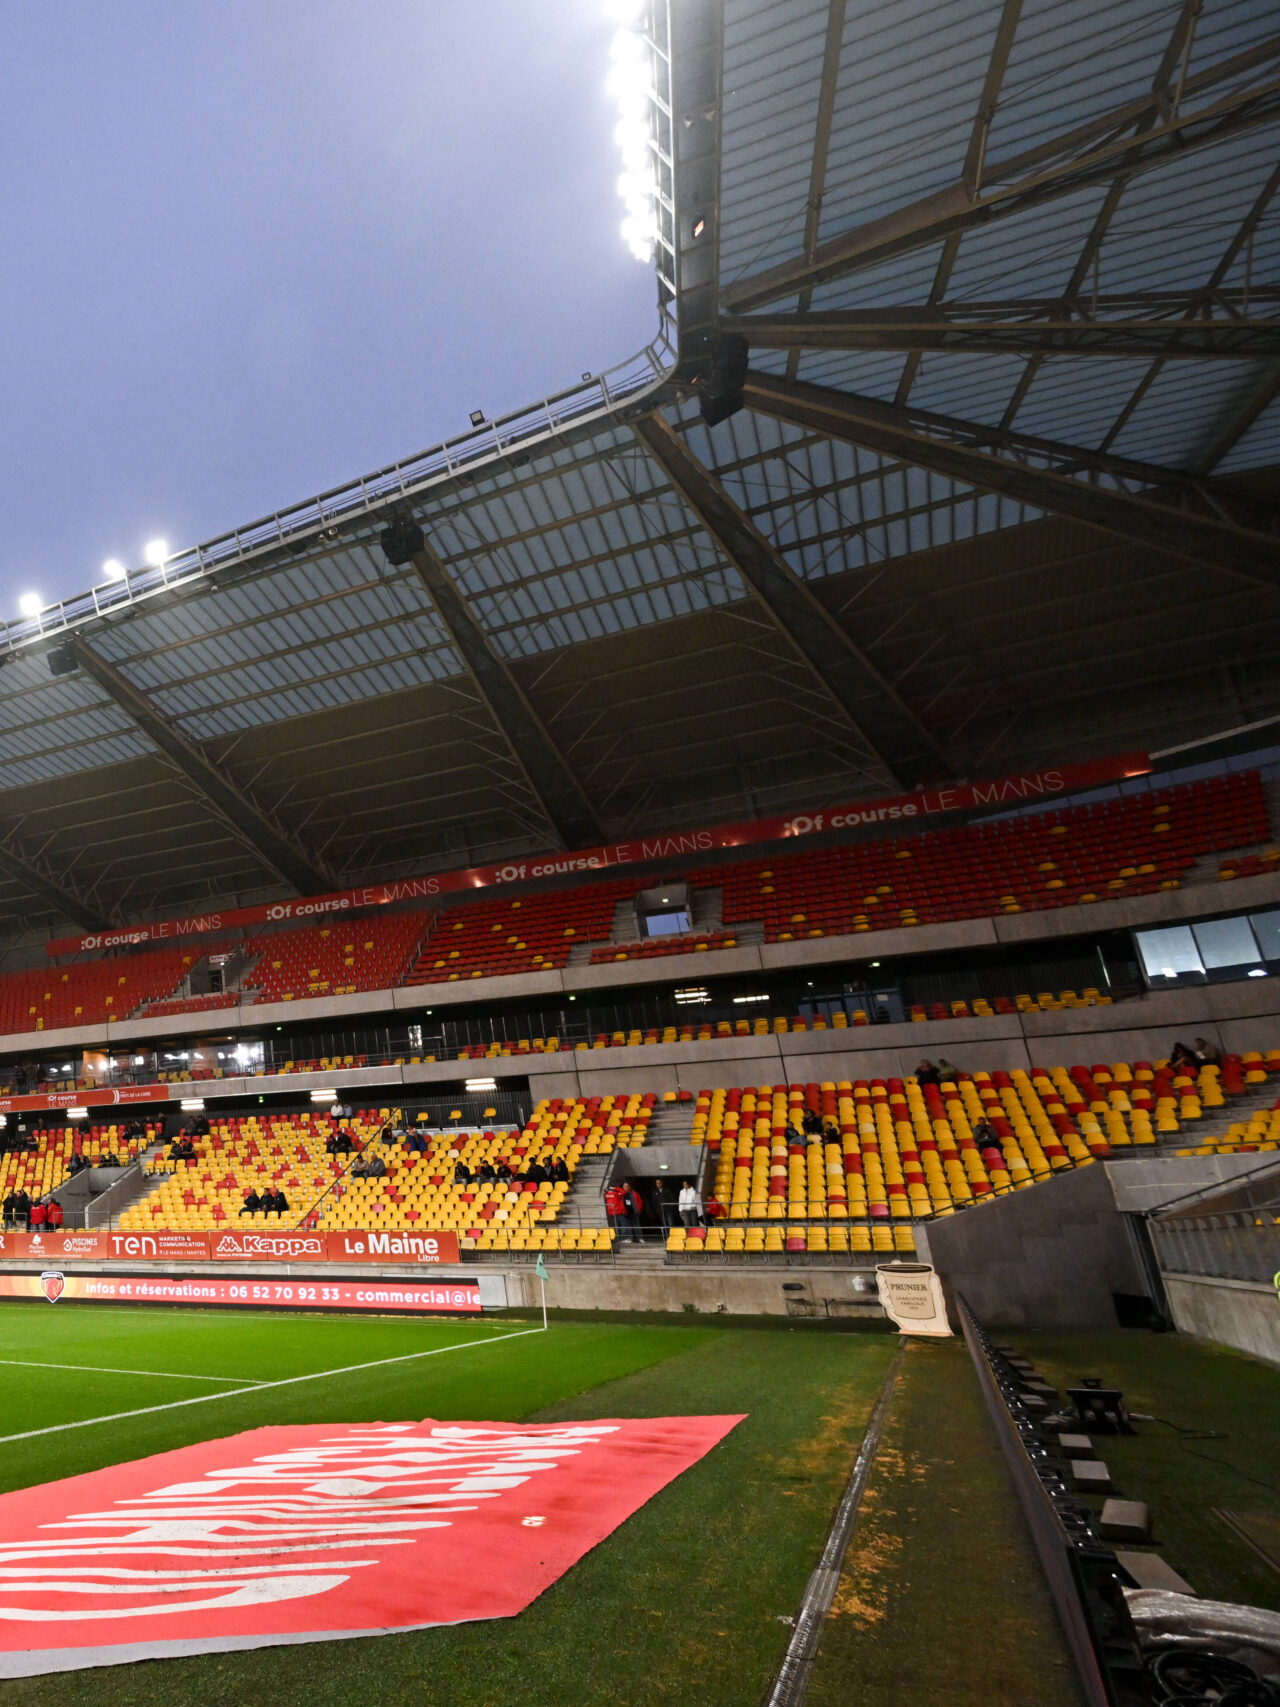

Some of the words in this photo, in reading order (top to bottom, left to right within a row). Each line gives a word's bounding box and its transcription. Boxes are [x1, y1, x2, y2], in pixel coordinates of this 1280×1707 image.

[830, 803, 918, 828] course
[922, 790, 960, 814] LE
[532, 856, 599, 876] course
[603, 845, 632, 864] LE
[642, 832, 712, 859] MANS
[296, 898, 349, 916] course
[352, 889, 375, 906] LE
[383, 878, 440, 900] MANS
[104, 930, 149, 948] course
[151, 923, 169, 939] LE
[176, 915, 221, 935] MANS
[72, 1238, 97, 1246] PISCINES
[244, 1236, 321, 1255] Kappa
[345, 1238, 365, 1253] Le
[368, 1232, 438, 1254] Maine
[86, 1282, 115, 1294] Infos
[120, 1284, 131, 1294] et
[136, 1283, 216, 1297] réservations
[221, 1288, 225, 1297] :
[229, 1286, 247, 1298] 06
[253, 1287, 269, 1298] 52
[276, 1287, 293, 1299] 70
[298, 1288, 316, 1299] 92
[322, 1288, 339, 1299] 33
[356, 1290, 480, 1306] commercial@le
